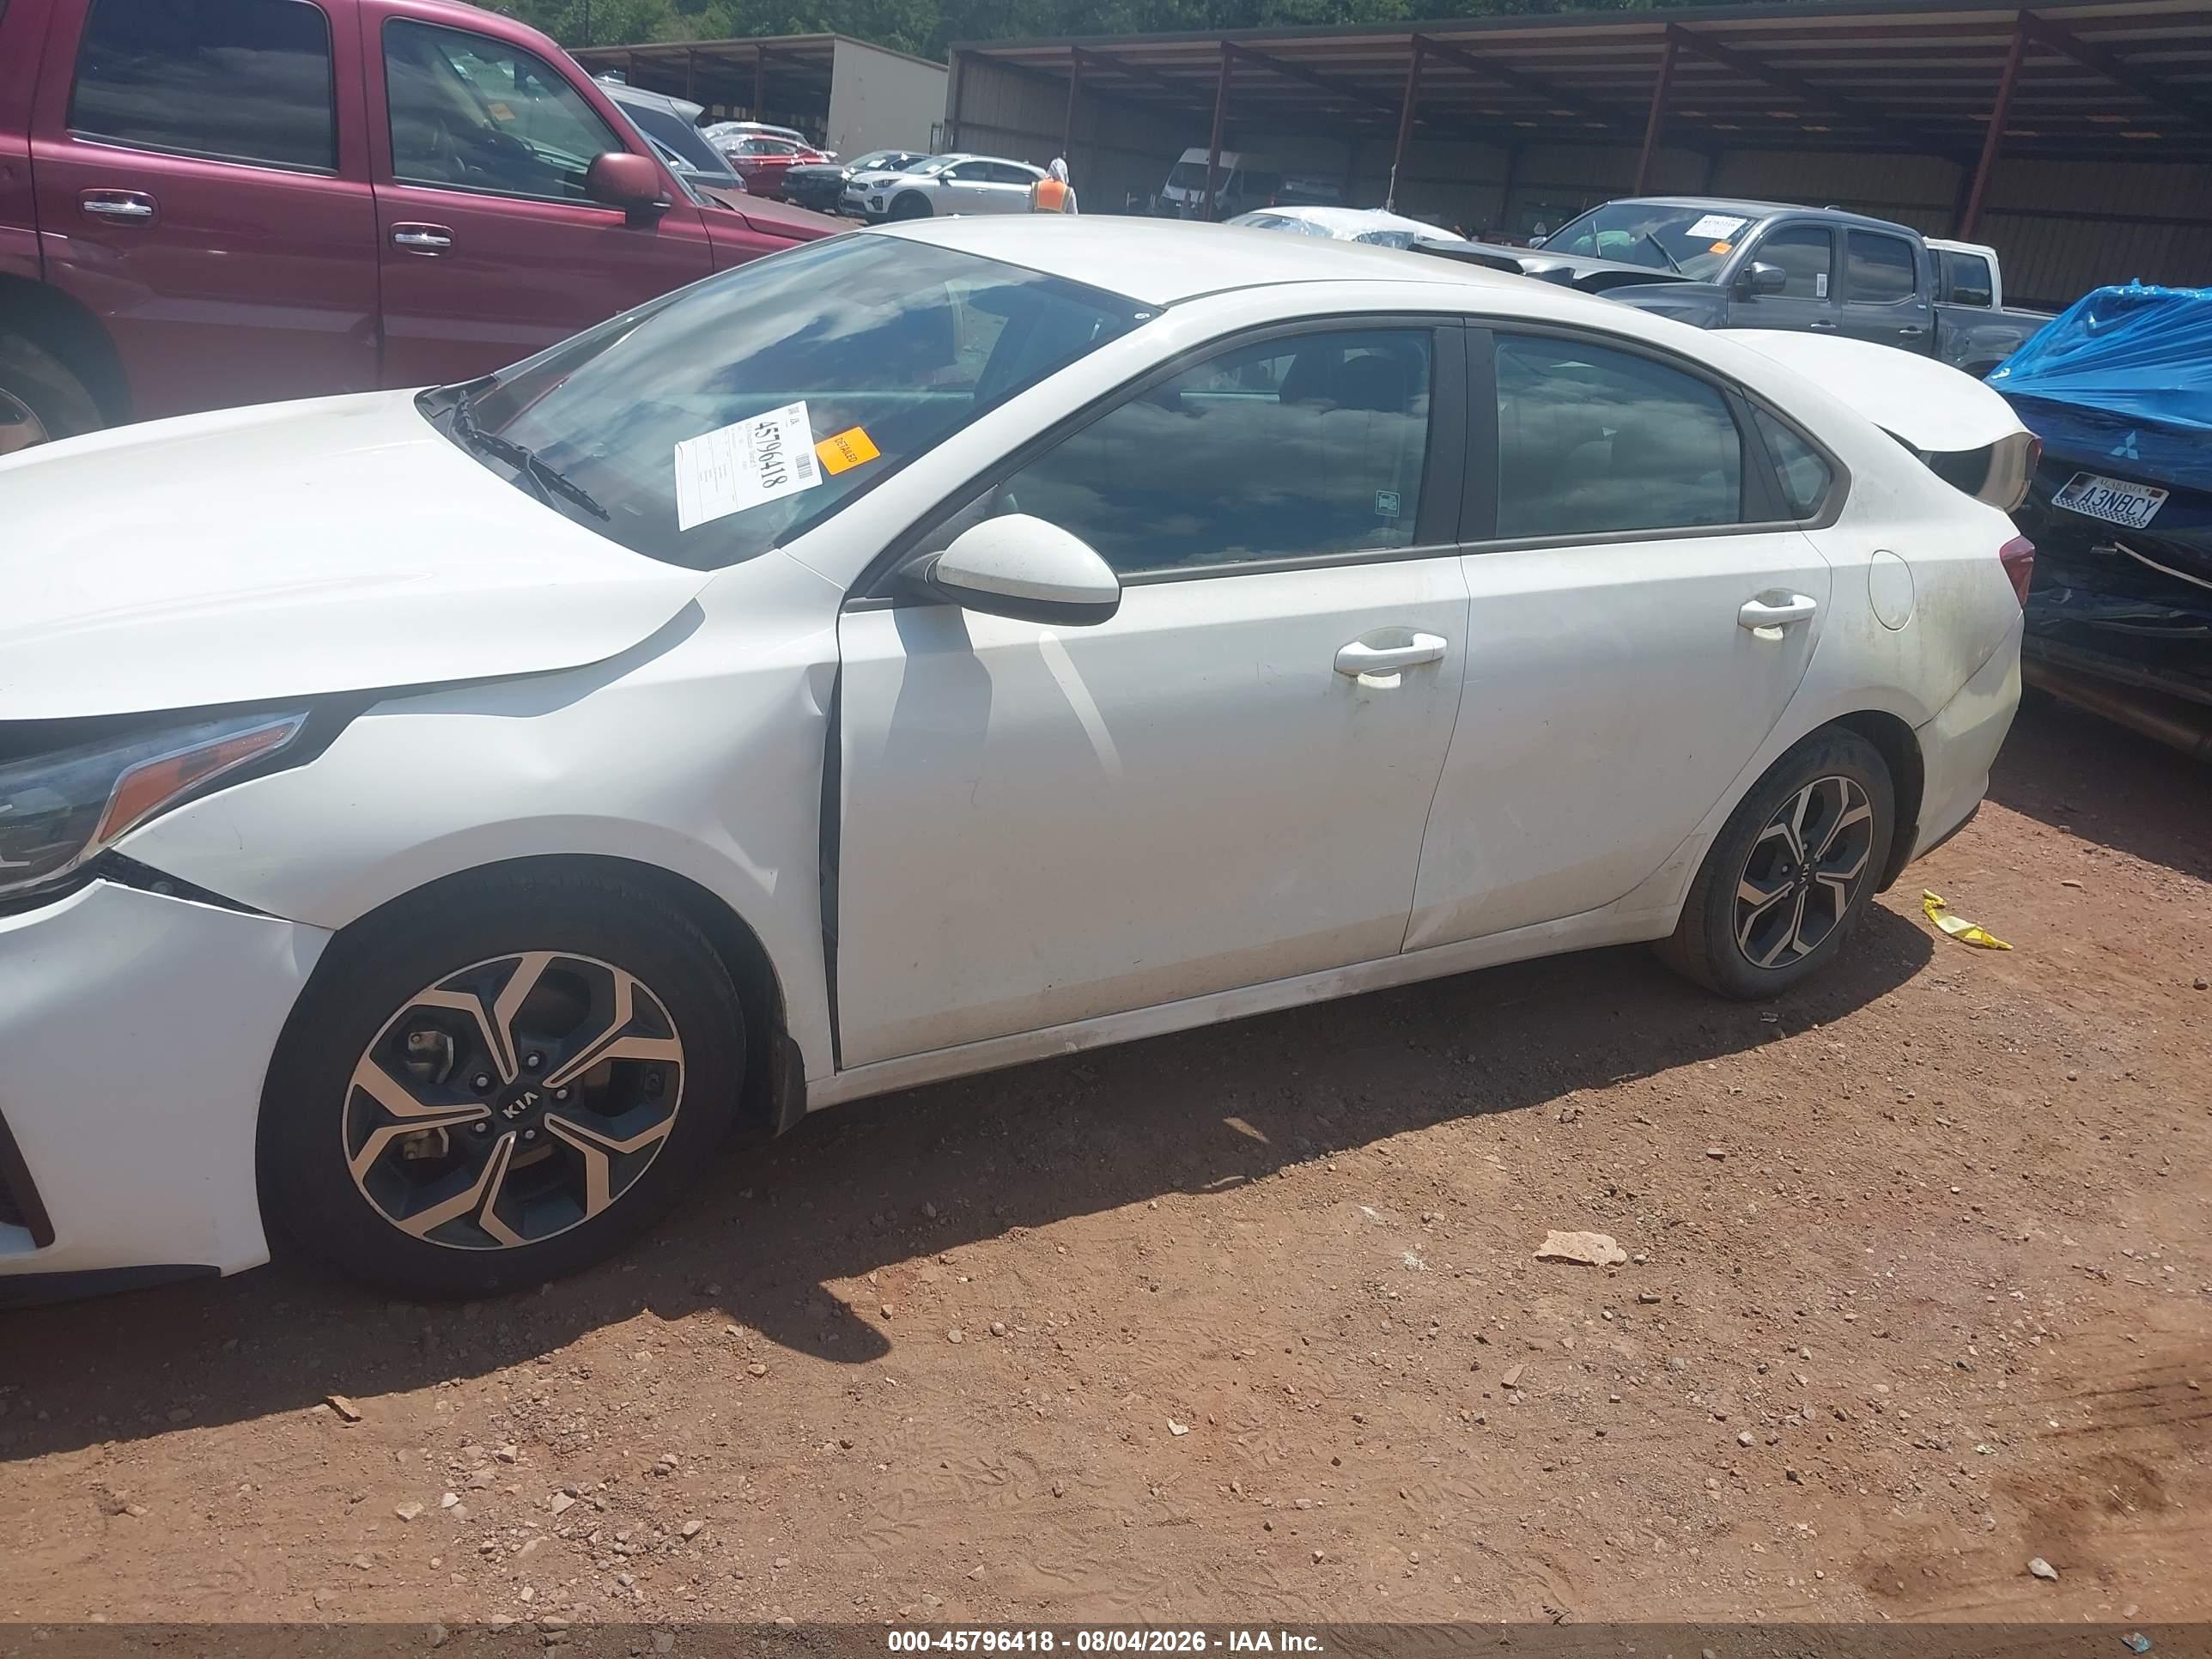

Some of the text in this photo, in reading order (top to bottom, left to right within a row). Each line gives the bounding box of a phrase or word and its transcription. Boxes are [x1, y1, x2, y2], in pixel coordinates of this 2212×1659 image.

[754, 422, 788, 489] 45796418
[834, 437, 859, 463] DETAILED
[2078, 486, 2159, 519] A3NBCY
[1799, 863, 1810, 884] KIA
[501, 1091, 539, 1119] KIA
